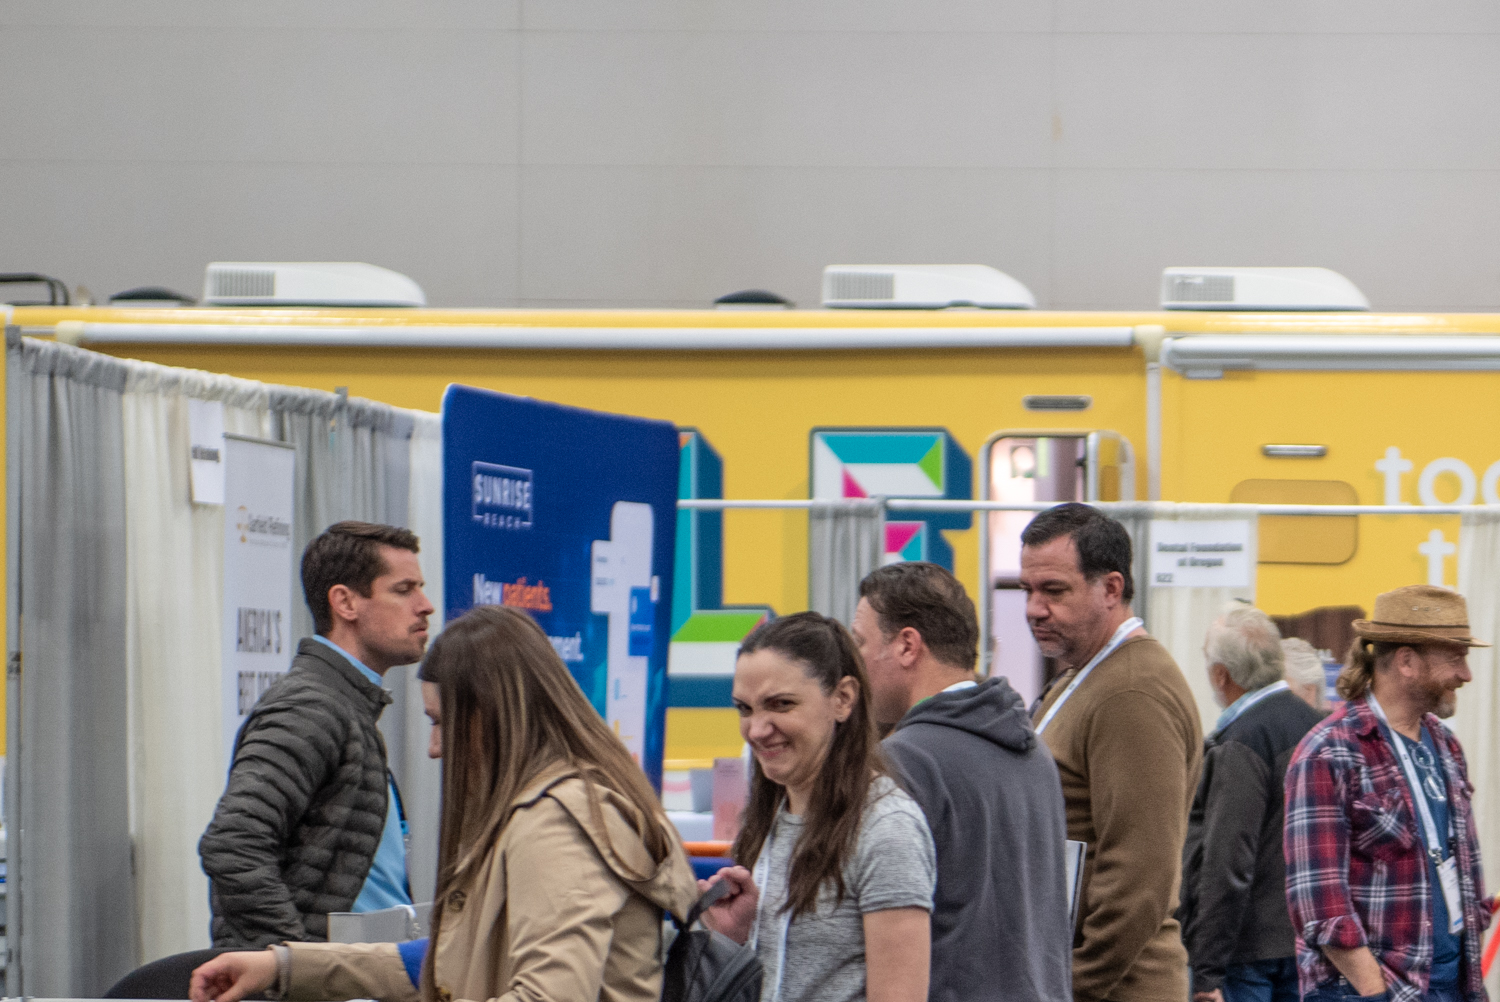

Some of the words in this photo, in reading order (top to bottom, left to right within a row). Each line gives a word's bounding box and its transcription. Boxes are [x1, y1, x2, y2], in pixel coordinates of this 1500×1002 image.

[474, 474, 532, 510] SUNRISE
[483, 512, 521, 529] REACH
[474, 572, 503, 606] New
